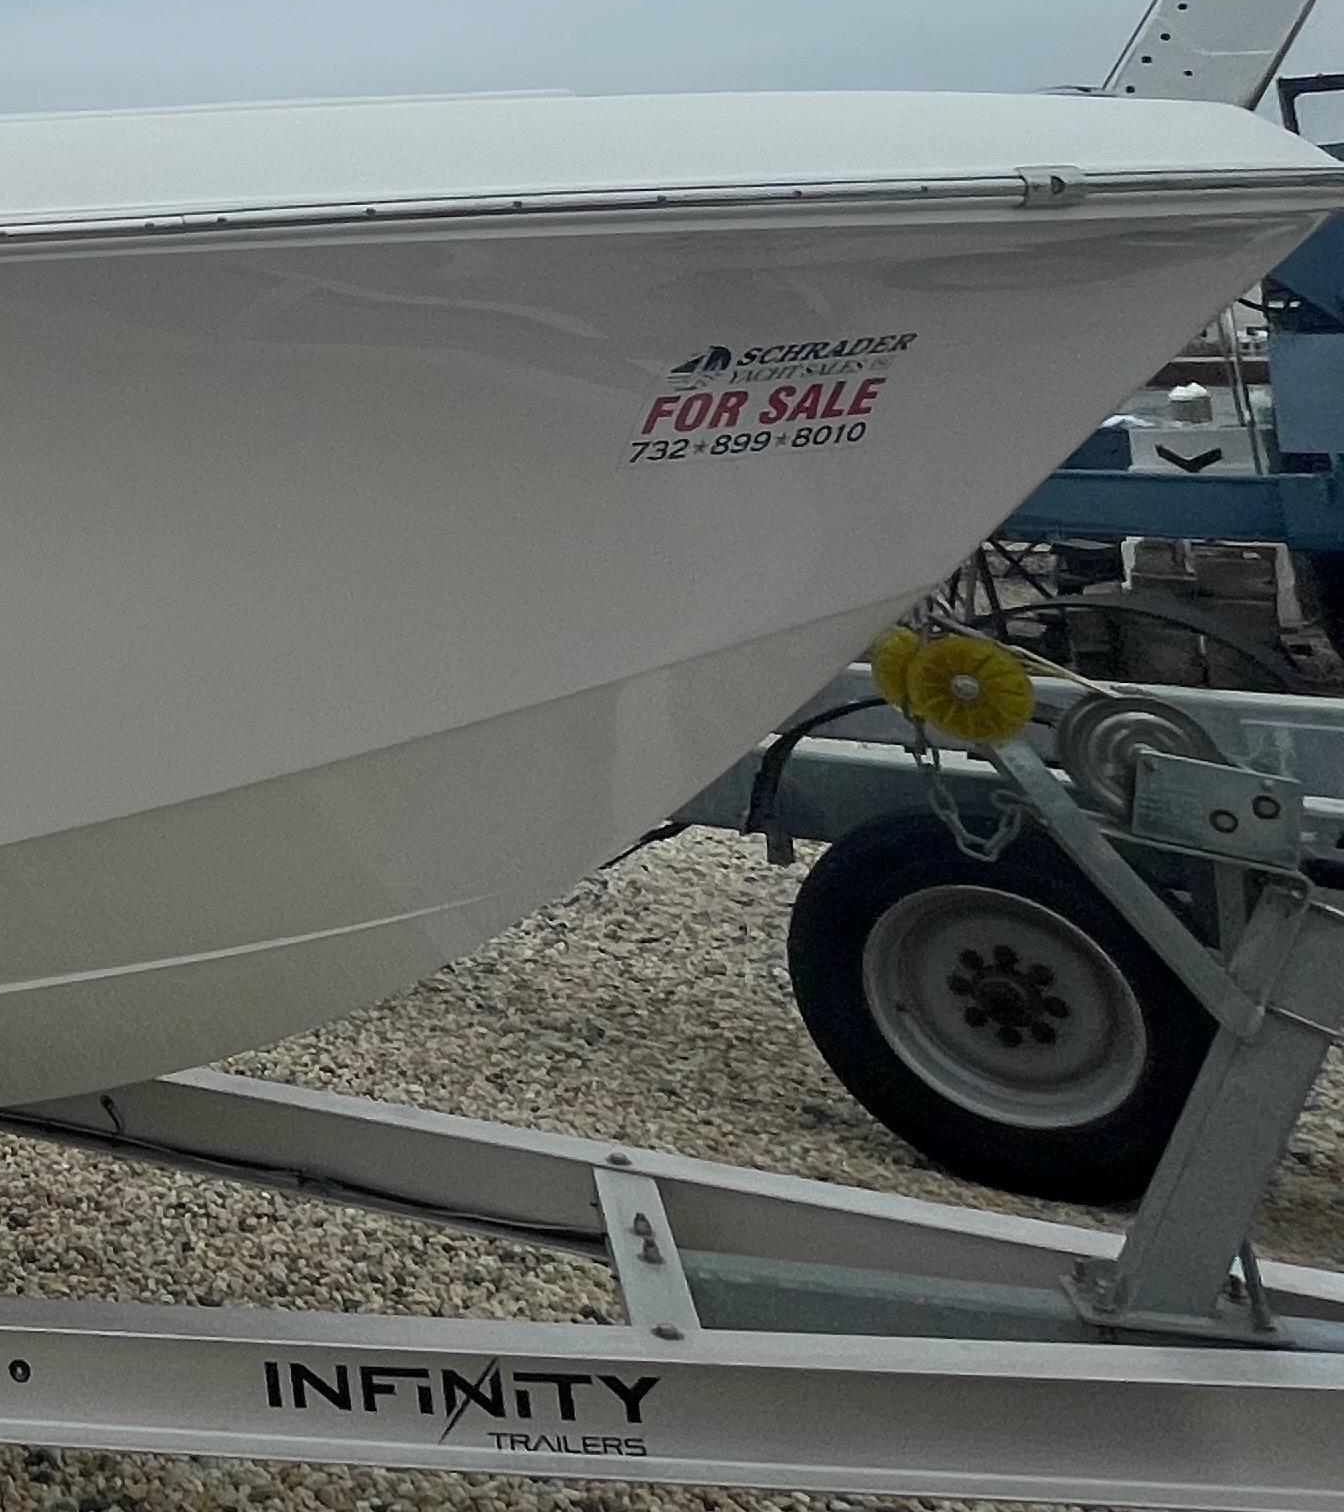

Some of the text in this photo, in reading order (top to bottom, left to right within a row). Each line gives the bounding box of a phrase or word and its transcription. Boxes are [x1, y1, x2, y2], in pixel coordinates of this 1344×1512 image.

[735, 333, 918, 366] SCHRADER
[640, 377, 888, 436] FOR SALE
[487, 1431, 648, 1457] TRAILERS
